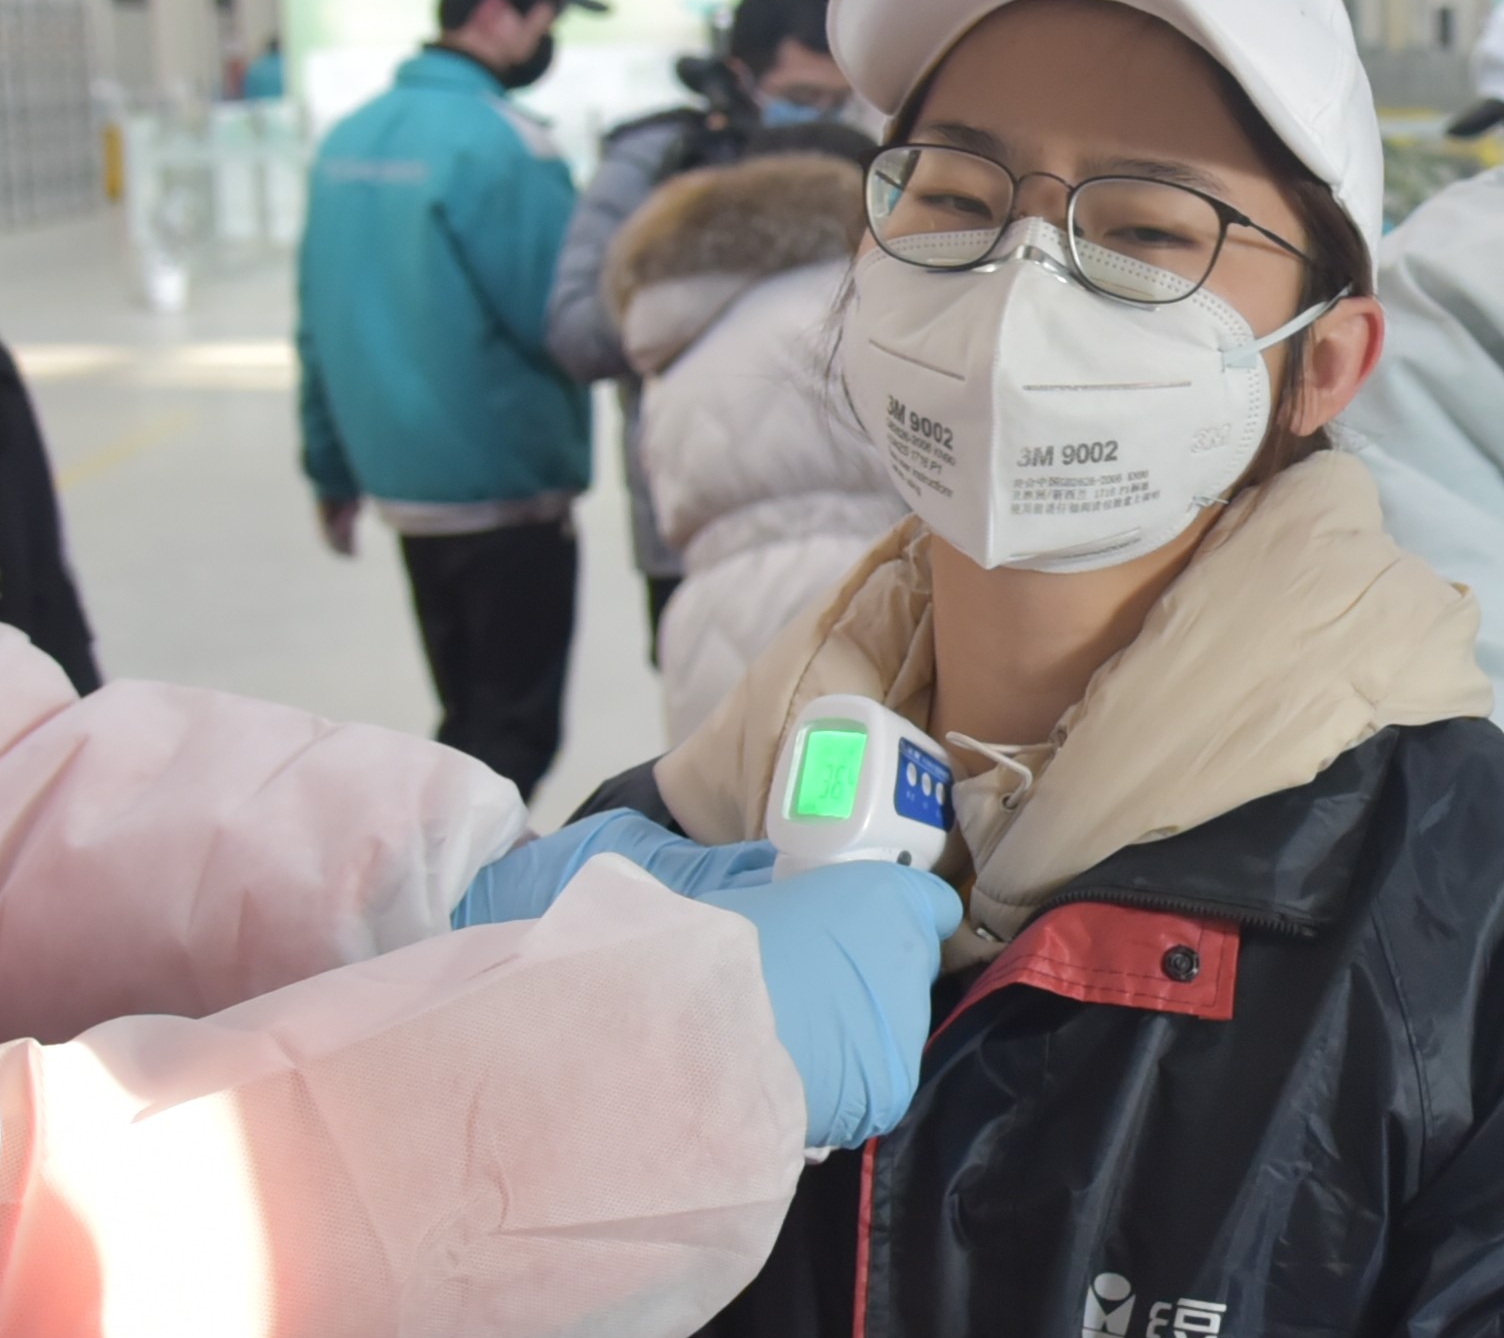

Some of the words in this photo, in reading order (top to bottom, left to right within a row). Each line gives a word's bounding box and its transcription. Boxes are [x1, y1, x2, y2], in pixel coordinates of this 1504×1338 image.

[887, 394, 906, 425] 3M
[910, 411, 953, 451] 9002
[1016, 445, 1054, 467] 3M
[1062, 440, 1119, 465] 9002
